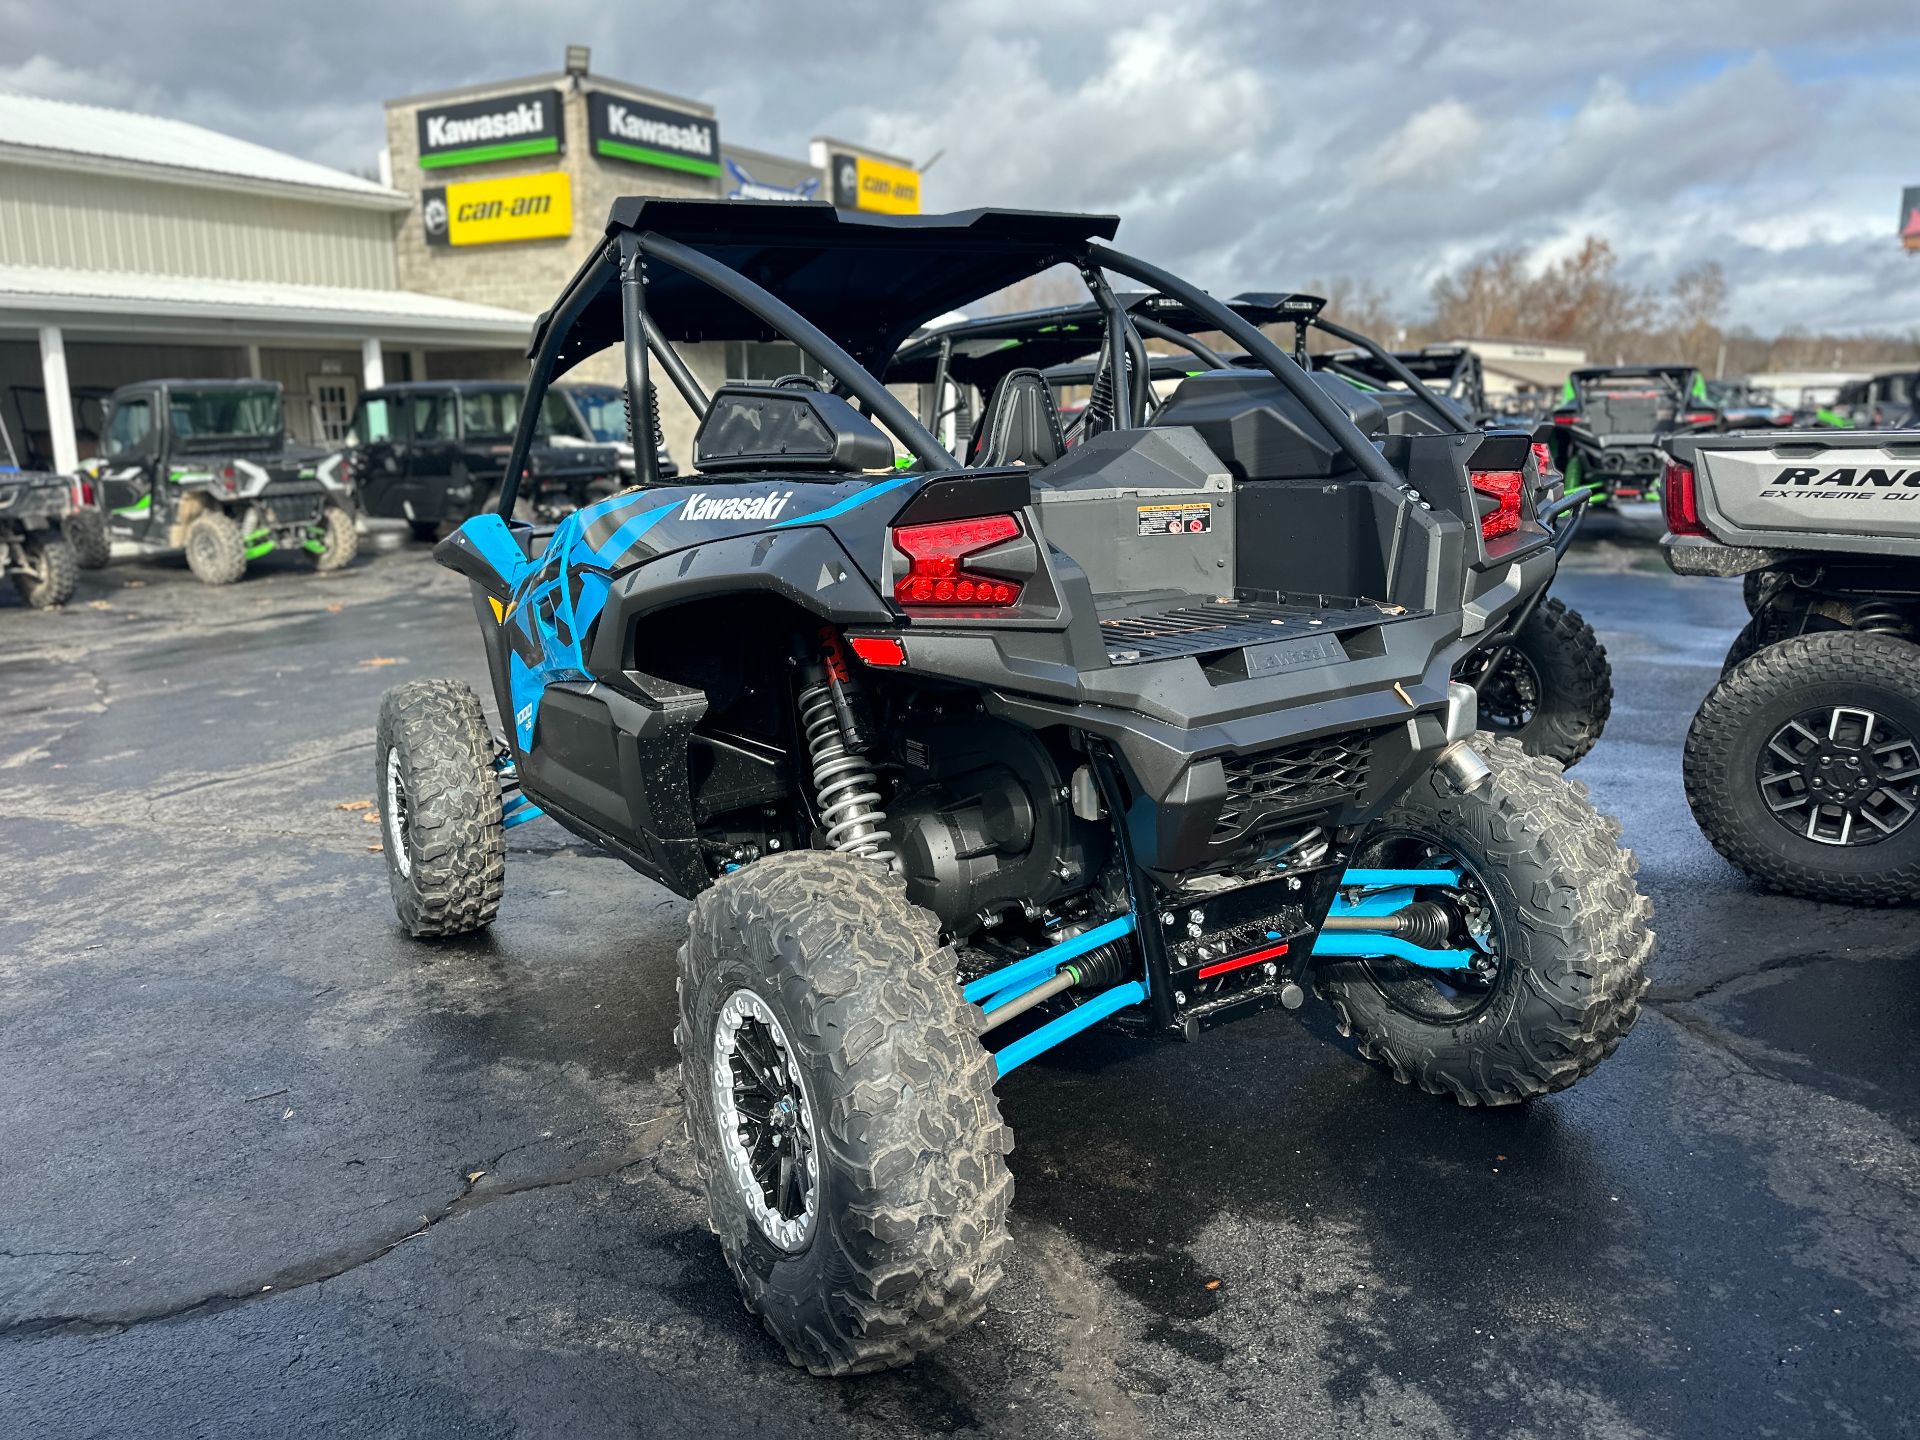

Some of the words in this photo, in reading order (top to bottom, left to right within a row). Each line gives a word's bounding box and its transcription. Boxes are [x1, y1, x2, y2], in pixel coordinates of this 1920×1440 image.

[427, 101, 543, 147] Kawasaki
[608, 104, 711, 155] Kawasaki
[457, 195, 551, 223] can-am
[679, 491, 794, 520] Kawasaki
[1759, 490, 1876, 500] EXTREME
